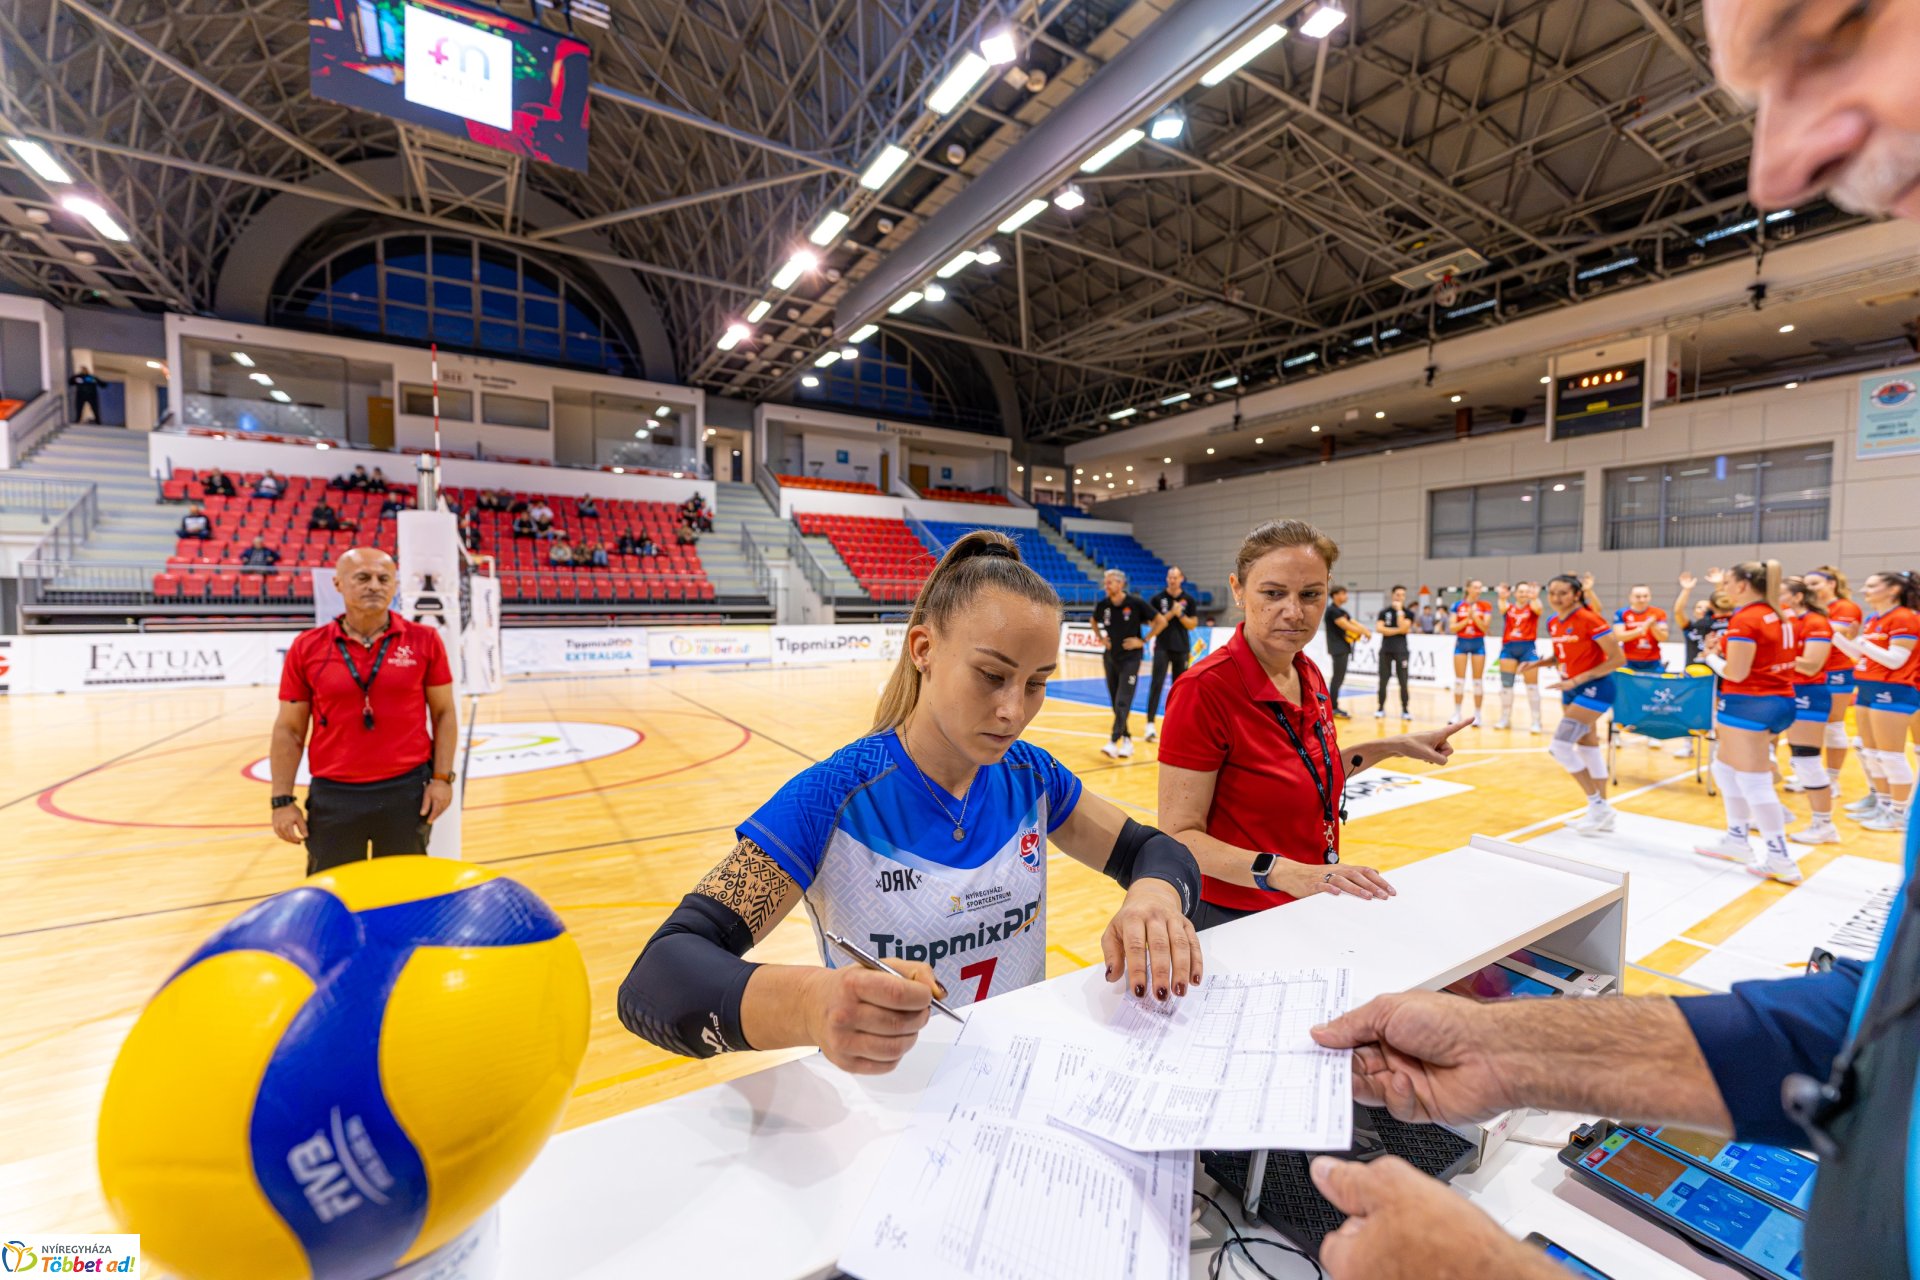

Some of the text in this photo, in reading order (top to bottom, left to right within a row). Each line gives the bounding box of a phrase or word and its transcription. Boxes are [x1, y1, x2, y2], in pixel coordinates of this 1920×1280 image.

[776, 636, 872, 654] TippmixPRO
[87, 642, 224, 671] FATUM
[565, 651, 634, 661] EXTRALIGA
[965, 886, 1003, 900] NYÍREGYHÁZI
[966, 891, 1012, 909] SPORTCENTRUM
[960, 957, 998, 1003] 7
